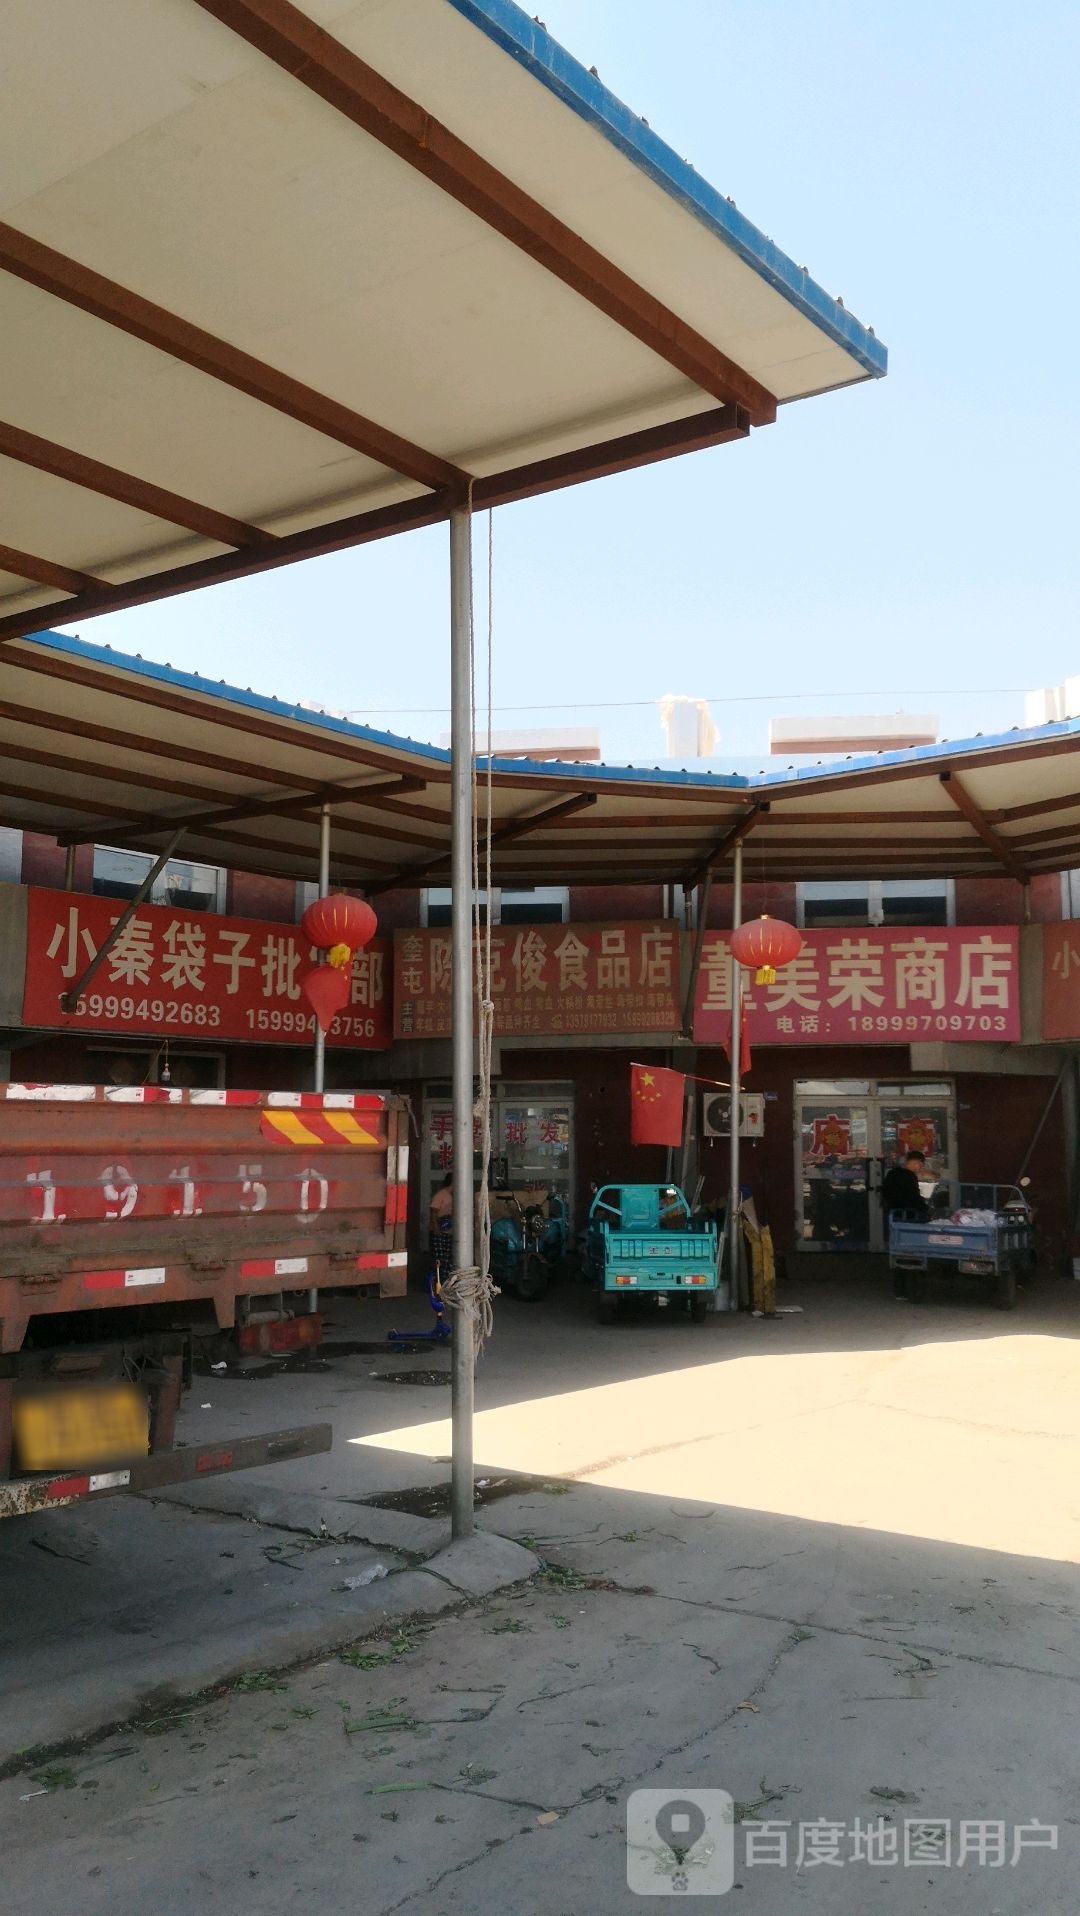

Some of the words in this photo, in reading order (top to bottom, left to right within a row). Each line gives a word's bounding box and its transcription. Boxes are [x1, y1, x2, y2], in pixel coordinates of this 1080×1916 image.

[46, 906, 384, 1009] 小秦袋子批部
[700, 935, 1013, 1012] 董美荣商店
[1052, 940, 1080, 979] 小
[59, 992, 220, 1026] 5999492683
[246, 1008, 375, 1038] 1599943756
[848, 1015, 1007, 1032] 18999709703
